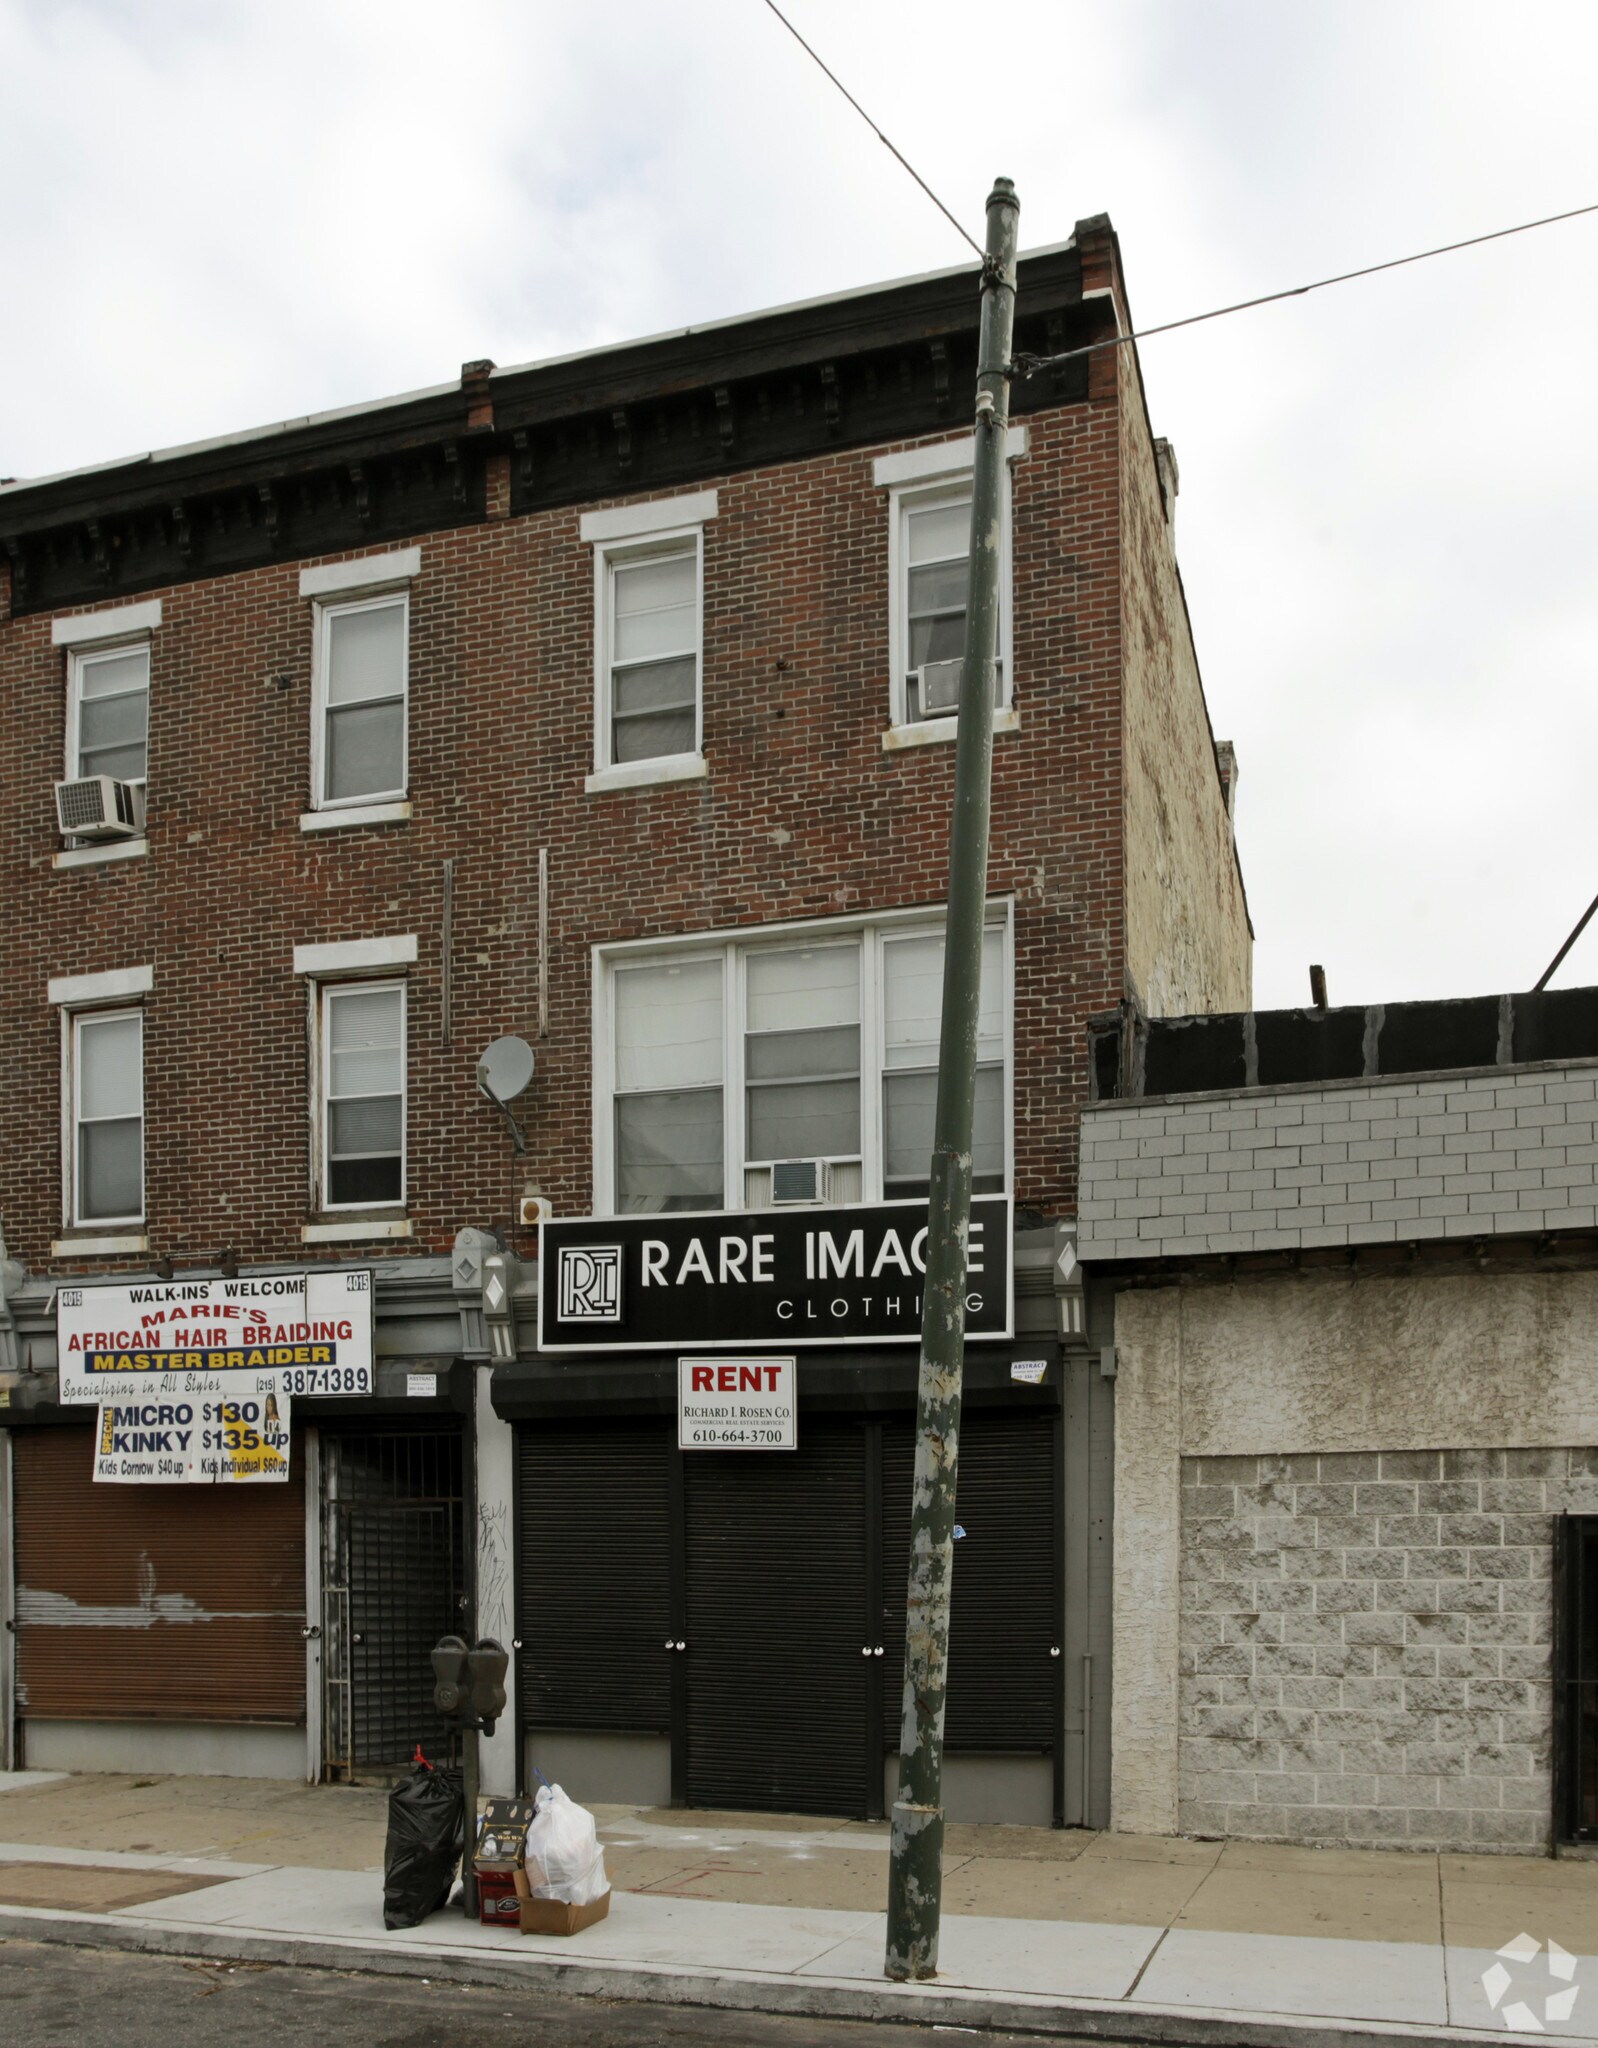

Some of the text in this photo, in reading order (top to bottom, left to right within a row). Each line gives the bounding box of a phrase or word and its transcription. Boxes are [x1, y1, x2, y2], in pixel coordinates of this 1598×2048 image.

[641, 1234, 775, 1287] RARE
[130, 1285, 209, 1304] WALK-INS
[347, 1274, 369, 1291] 4015
[63, 1291, 82, 1307] 4015
[776, 1293, 984, 1319] CLOTHIG
[141, 1304, 268, 1328] MARIE'S
[68, 1320, 353, 1352] AFRICAN HAIR BRAIDING
[93, 1346, 331, 1371] MASTER BRAIDER
[63, 1372, 221, 1402] Specializing in All Styles
[256, 1367, 368, 1393] (215) 387-1389
[692, 1366, 782, 1392] RENT
[113, 1402, 260, 1427] MICRO $130
[102, 1408, 113, 1454] SPECIAL
[113, 1429, 289, 1453] KINKY $135 up
[693, 1430, 782, 1442] 610-664-3700
[99, 1459, 117, 1475] Kids
[158, 1459, 172, 1475] $40
[174, 1462, 184, 1478] up
[201, 1458, 219, 1474] Kids
[222, 1457, 260, 1473] Individual
